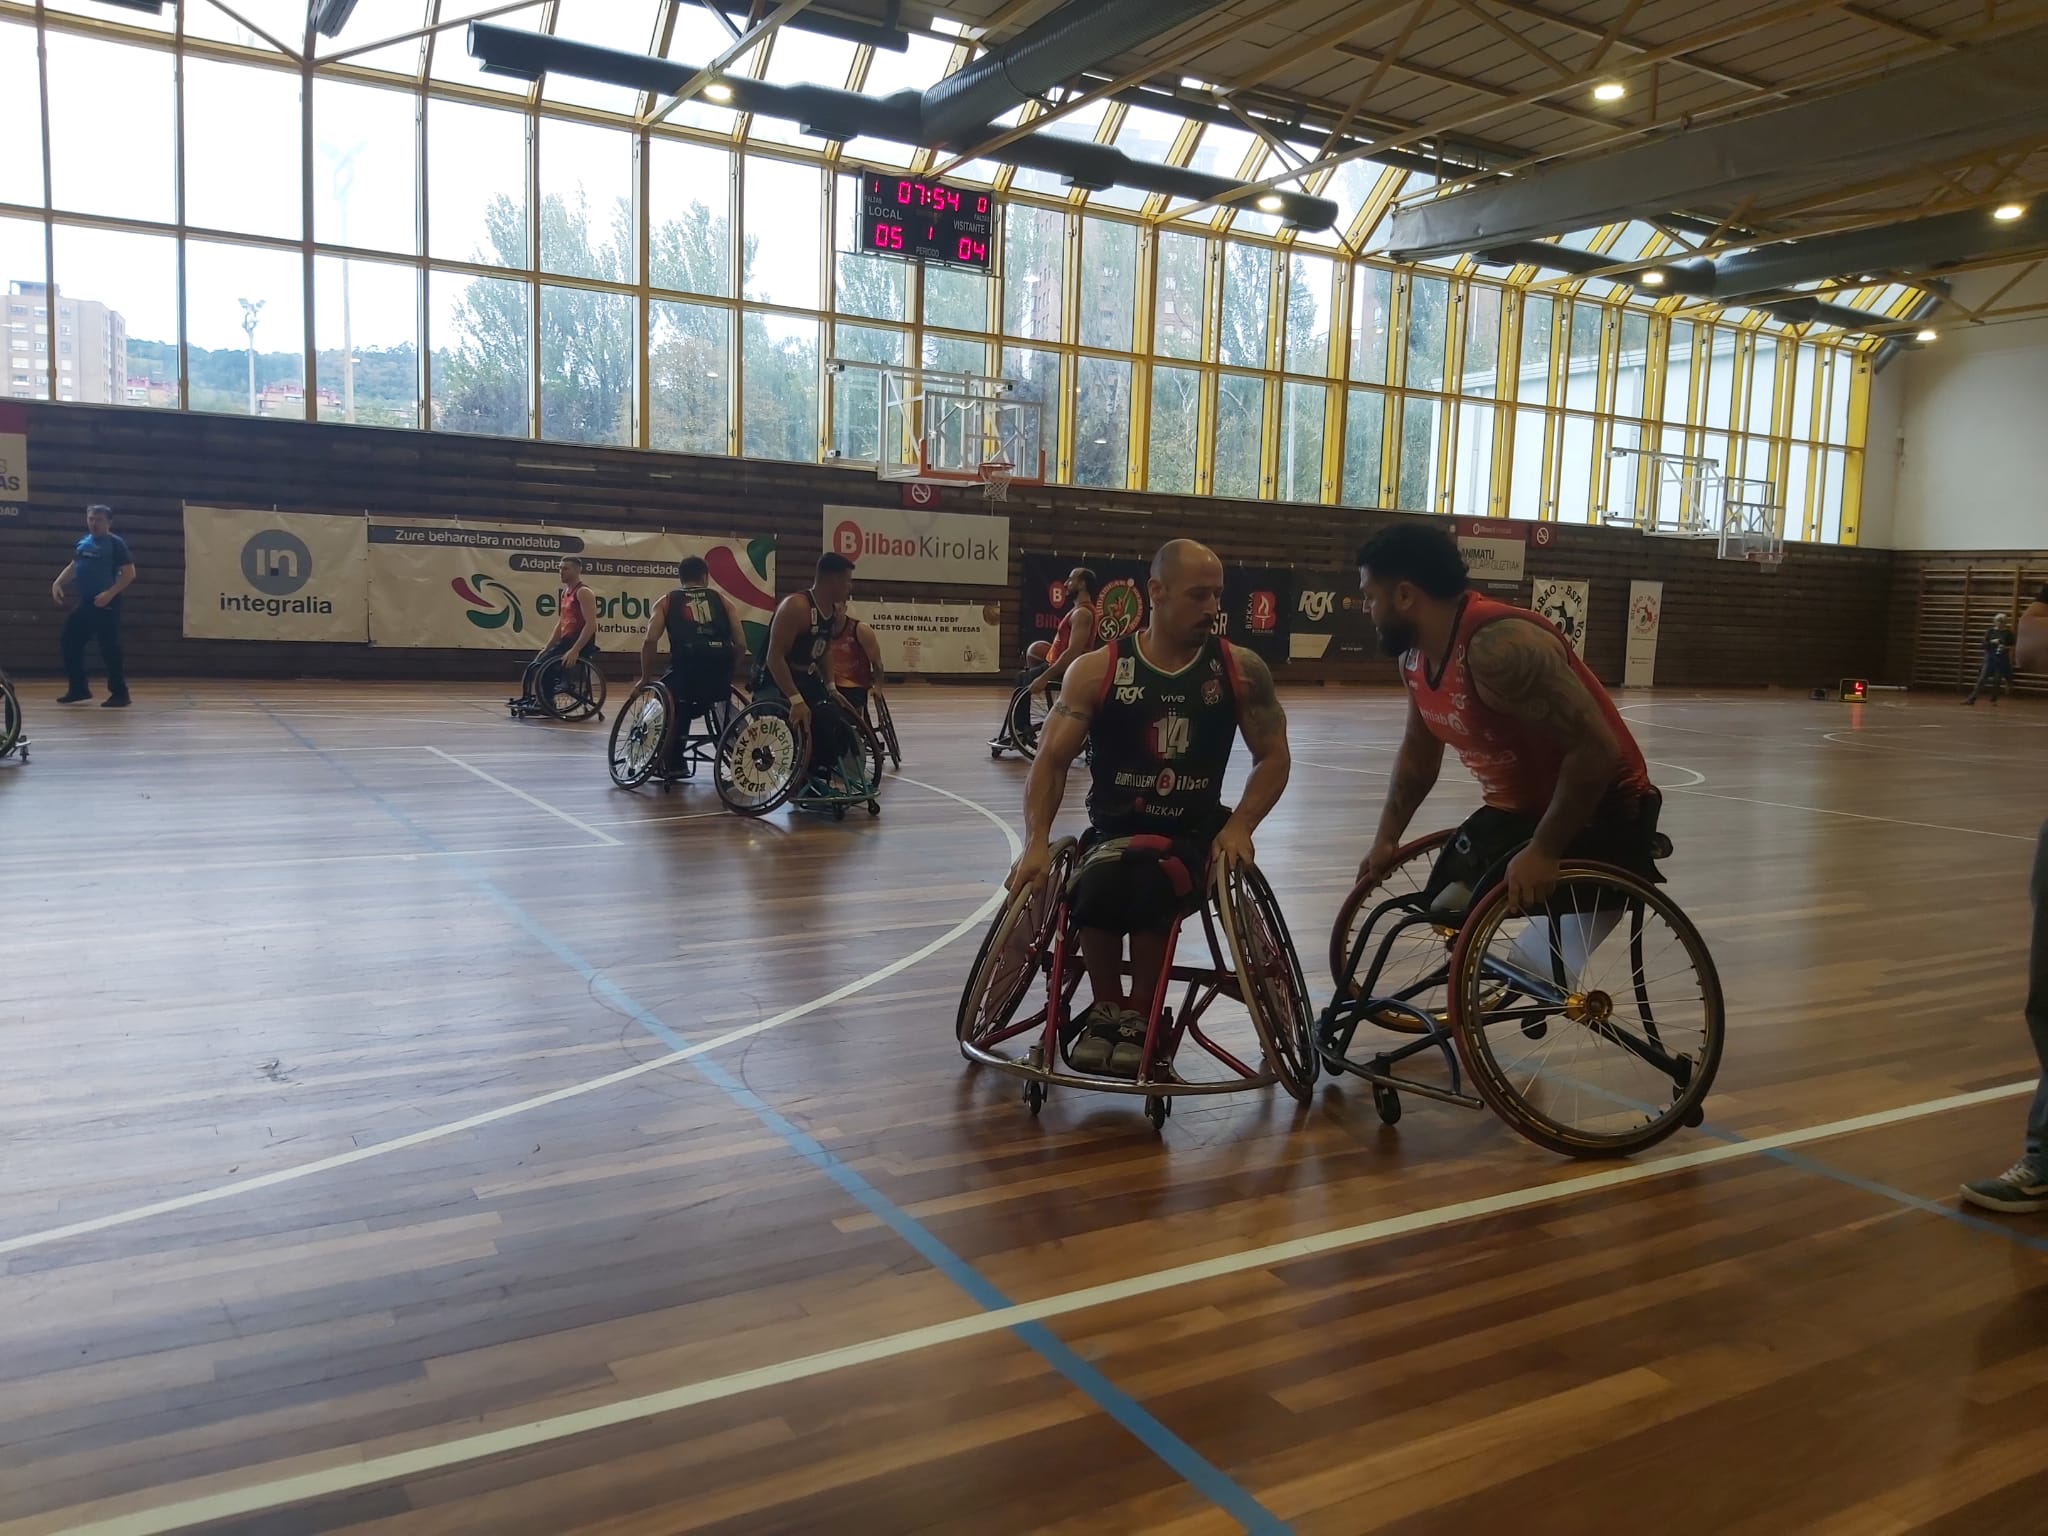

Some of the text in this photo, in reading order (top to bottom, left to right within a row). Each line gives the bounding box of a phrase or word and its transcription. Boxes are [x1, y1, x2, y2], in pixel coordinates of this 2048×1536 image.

[897, 181, 960, 212] 07:54
[977, 197, 988, 214] 0
[868, 205, 903, 221] LOCAL
[874, 223, 903, 250] 05
[953, 219, 985, 235] VISITANTE
[915, 245, 940, 258] PERIODO
[958, 236, 985, 261] 04
[395, 530, 560, 549] Zure beharretara moldatuta
[586, 563, 593, 571] a
[596, 561, 613, 572] tus
[617, 564, 680, 576] necesidade
[220, 592, 333, 617] integralia
[1565, 585, 1583, 607] BSR
[873, 613, 892, 621] LIGA
[894, 614, 932, 623] NACIONAL
[1160, 695, 1186, 703] vive
[1153, 716, 1190, 754] 14
[760, 721, 790, 777] elkarbus
